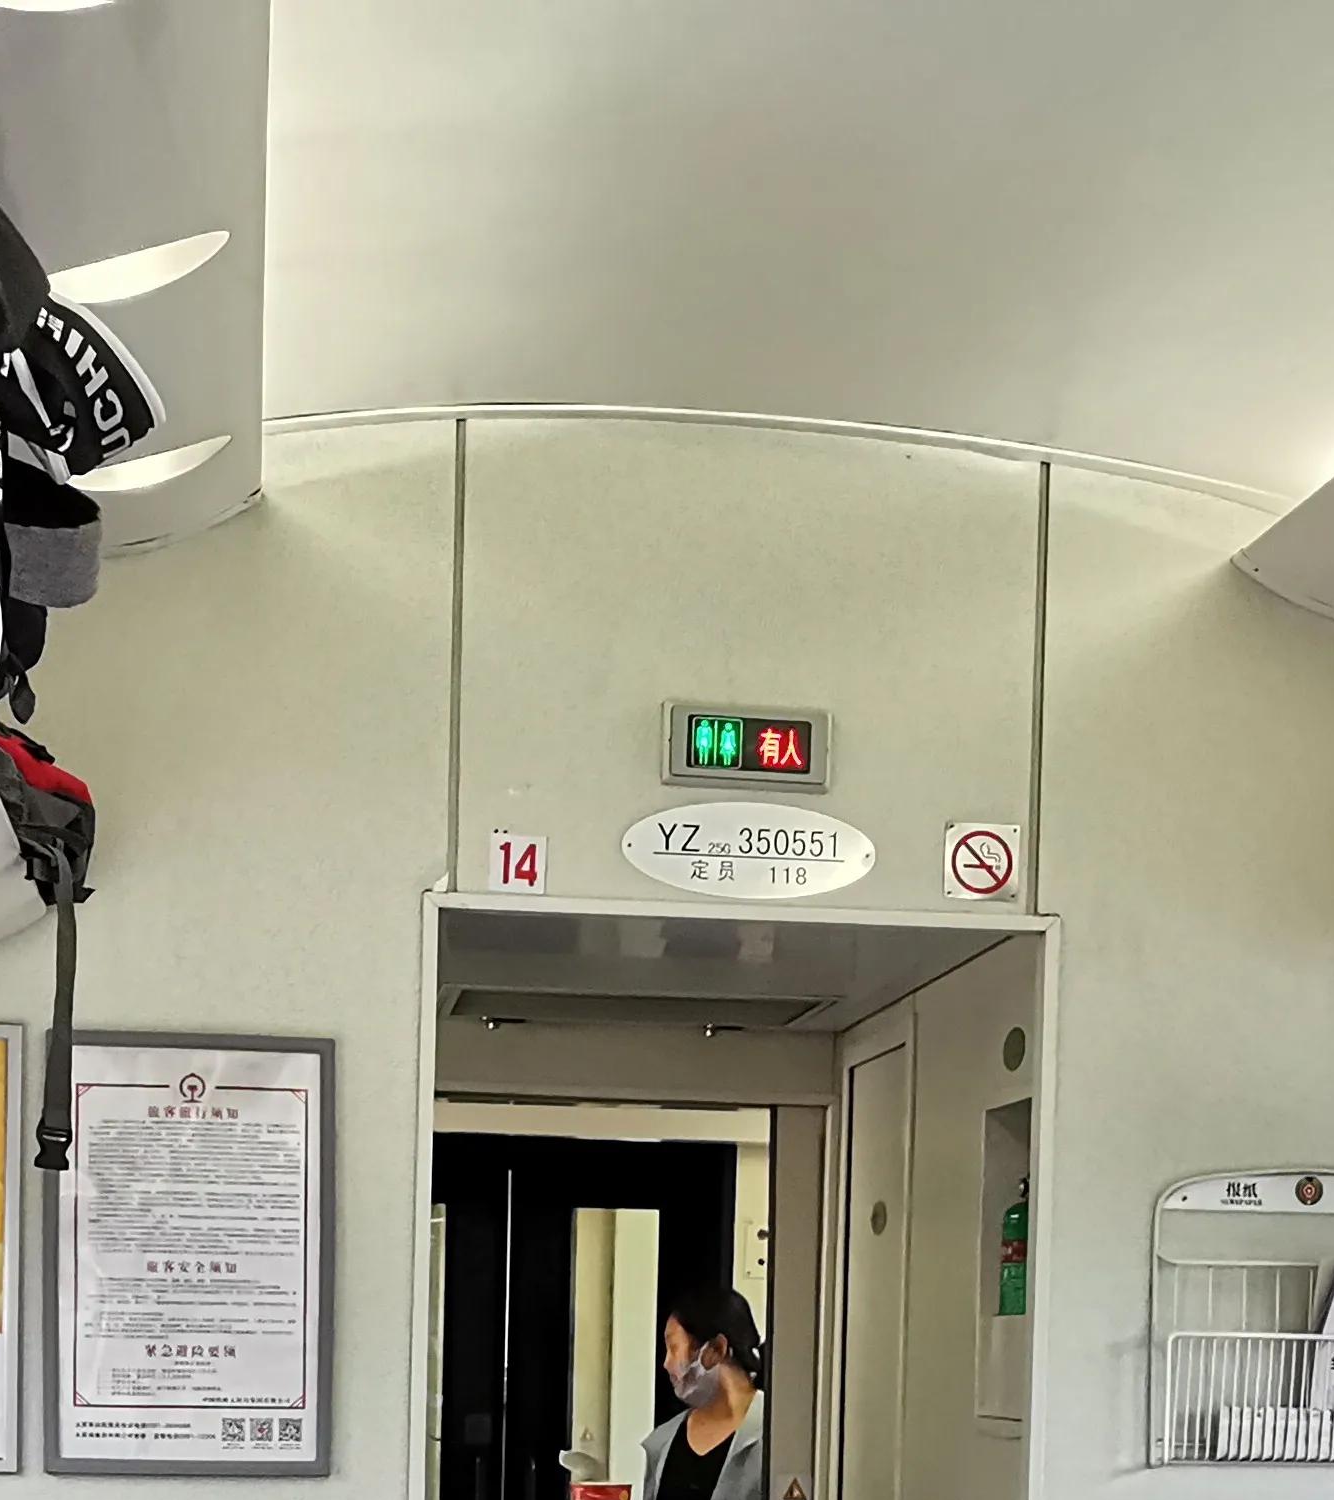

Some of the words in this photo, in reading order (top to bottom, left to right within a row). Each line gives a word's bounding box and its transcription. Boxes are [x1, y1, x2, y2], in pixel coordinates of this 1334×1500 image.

[758, 728, 803, 768] 有人
[738, 827, 839, 858] 350551
[498, 840, 538, 887] 14
[690, 860, 735, 882] 定员
[769, 865, 807, 886] 118
